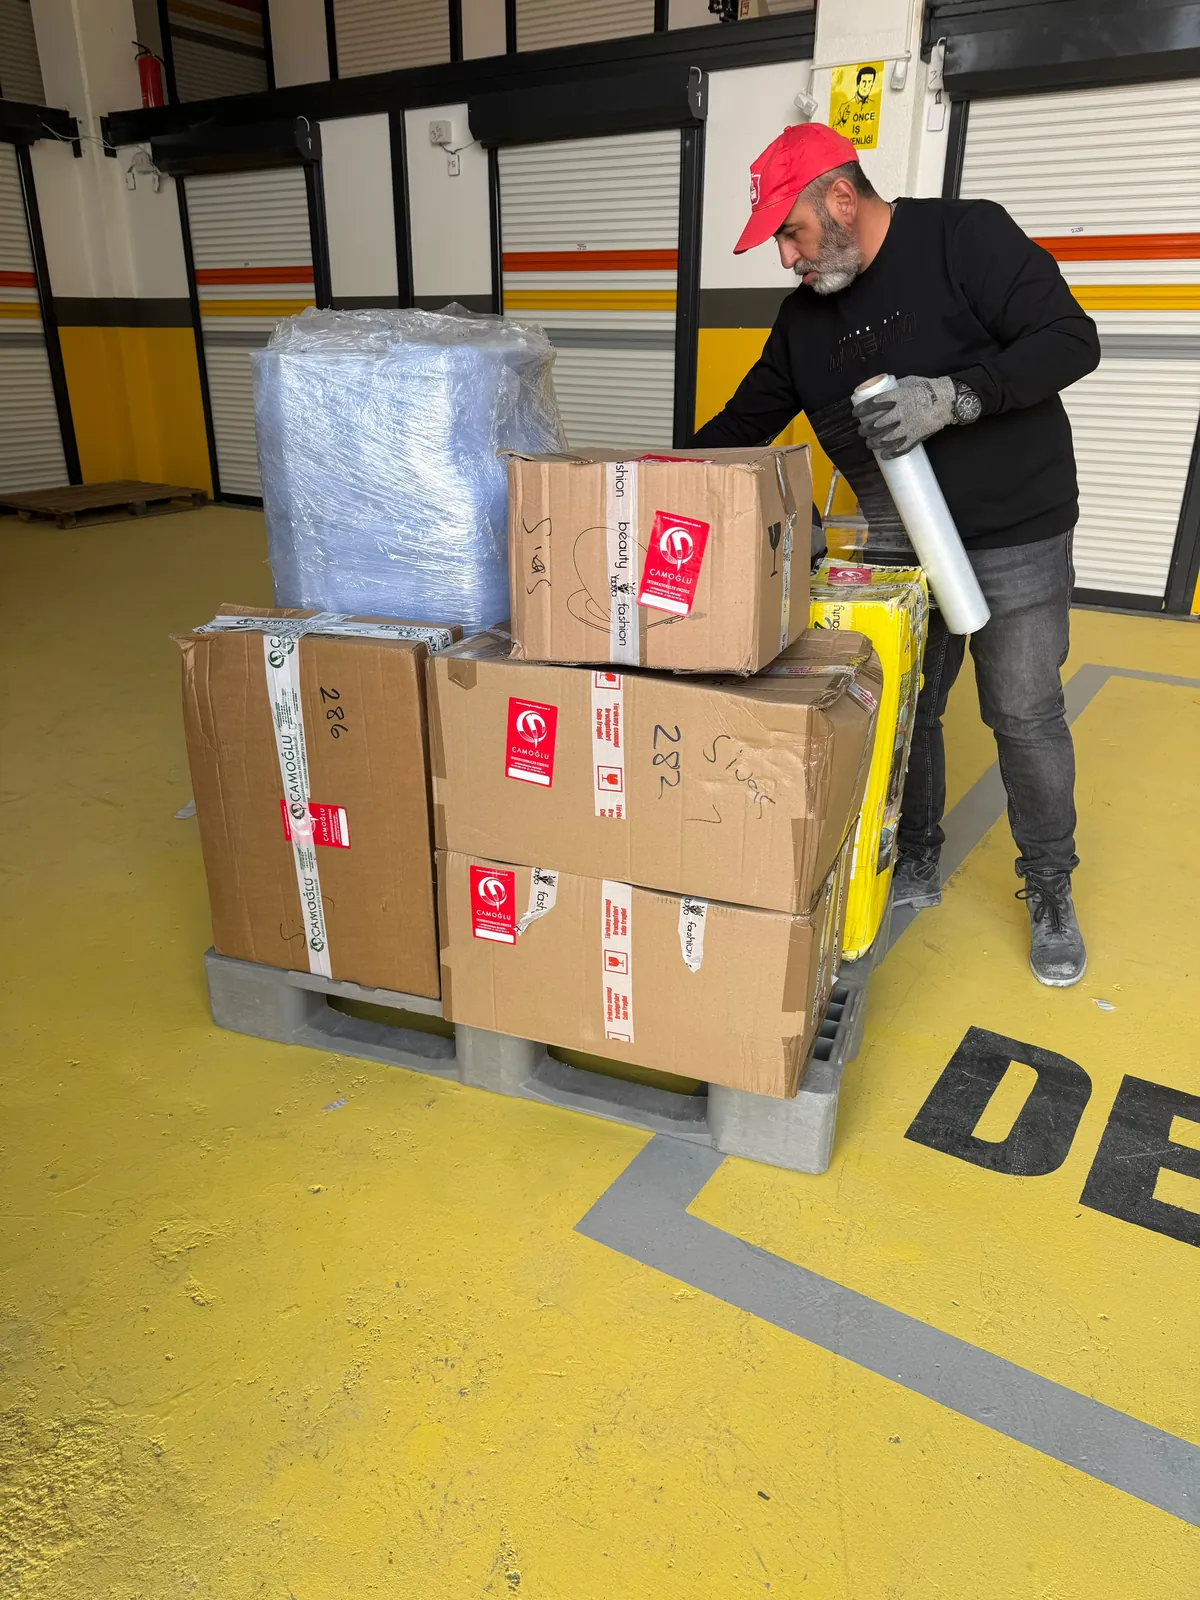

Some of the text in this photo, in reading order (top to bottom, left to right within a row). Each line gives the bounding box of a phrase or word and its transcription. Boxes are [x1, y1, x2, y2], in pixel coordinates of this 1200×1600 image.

[849, 134, 873, 145] ENLİĞİ
[851, 124, 861, 135] İŞ
[852, 111, 875, 122] ÖNCE
[614, 521, 631, 569] beauty
[617, 602, 630, 647] fashion
[319, 686, 349, 740] 286
[281, 735, 303, 802] ÇAMOĞLU
[652, 724, 682, 800] 282
